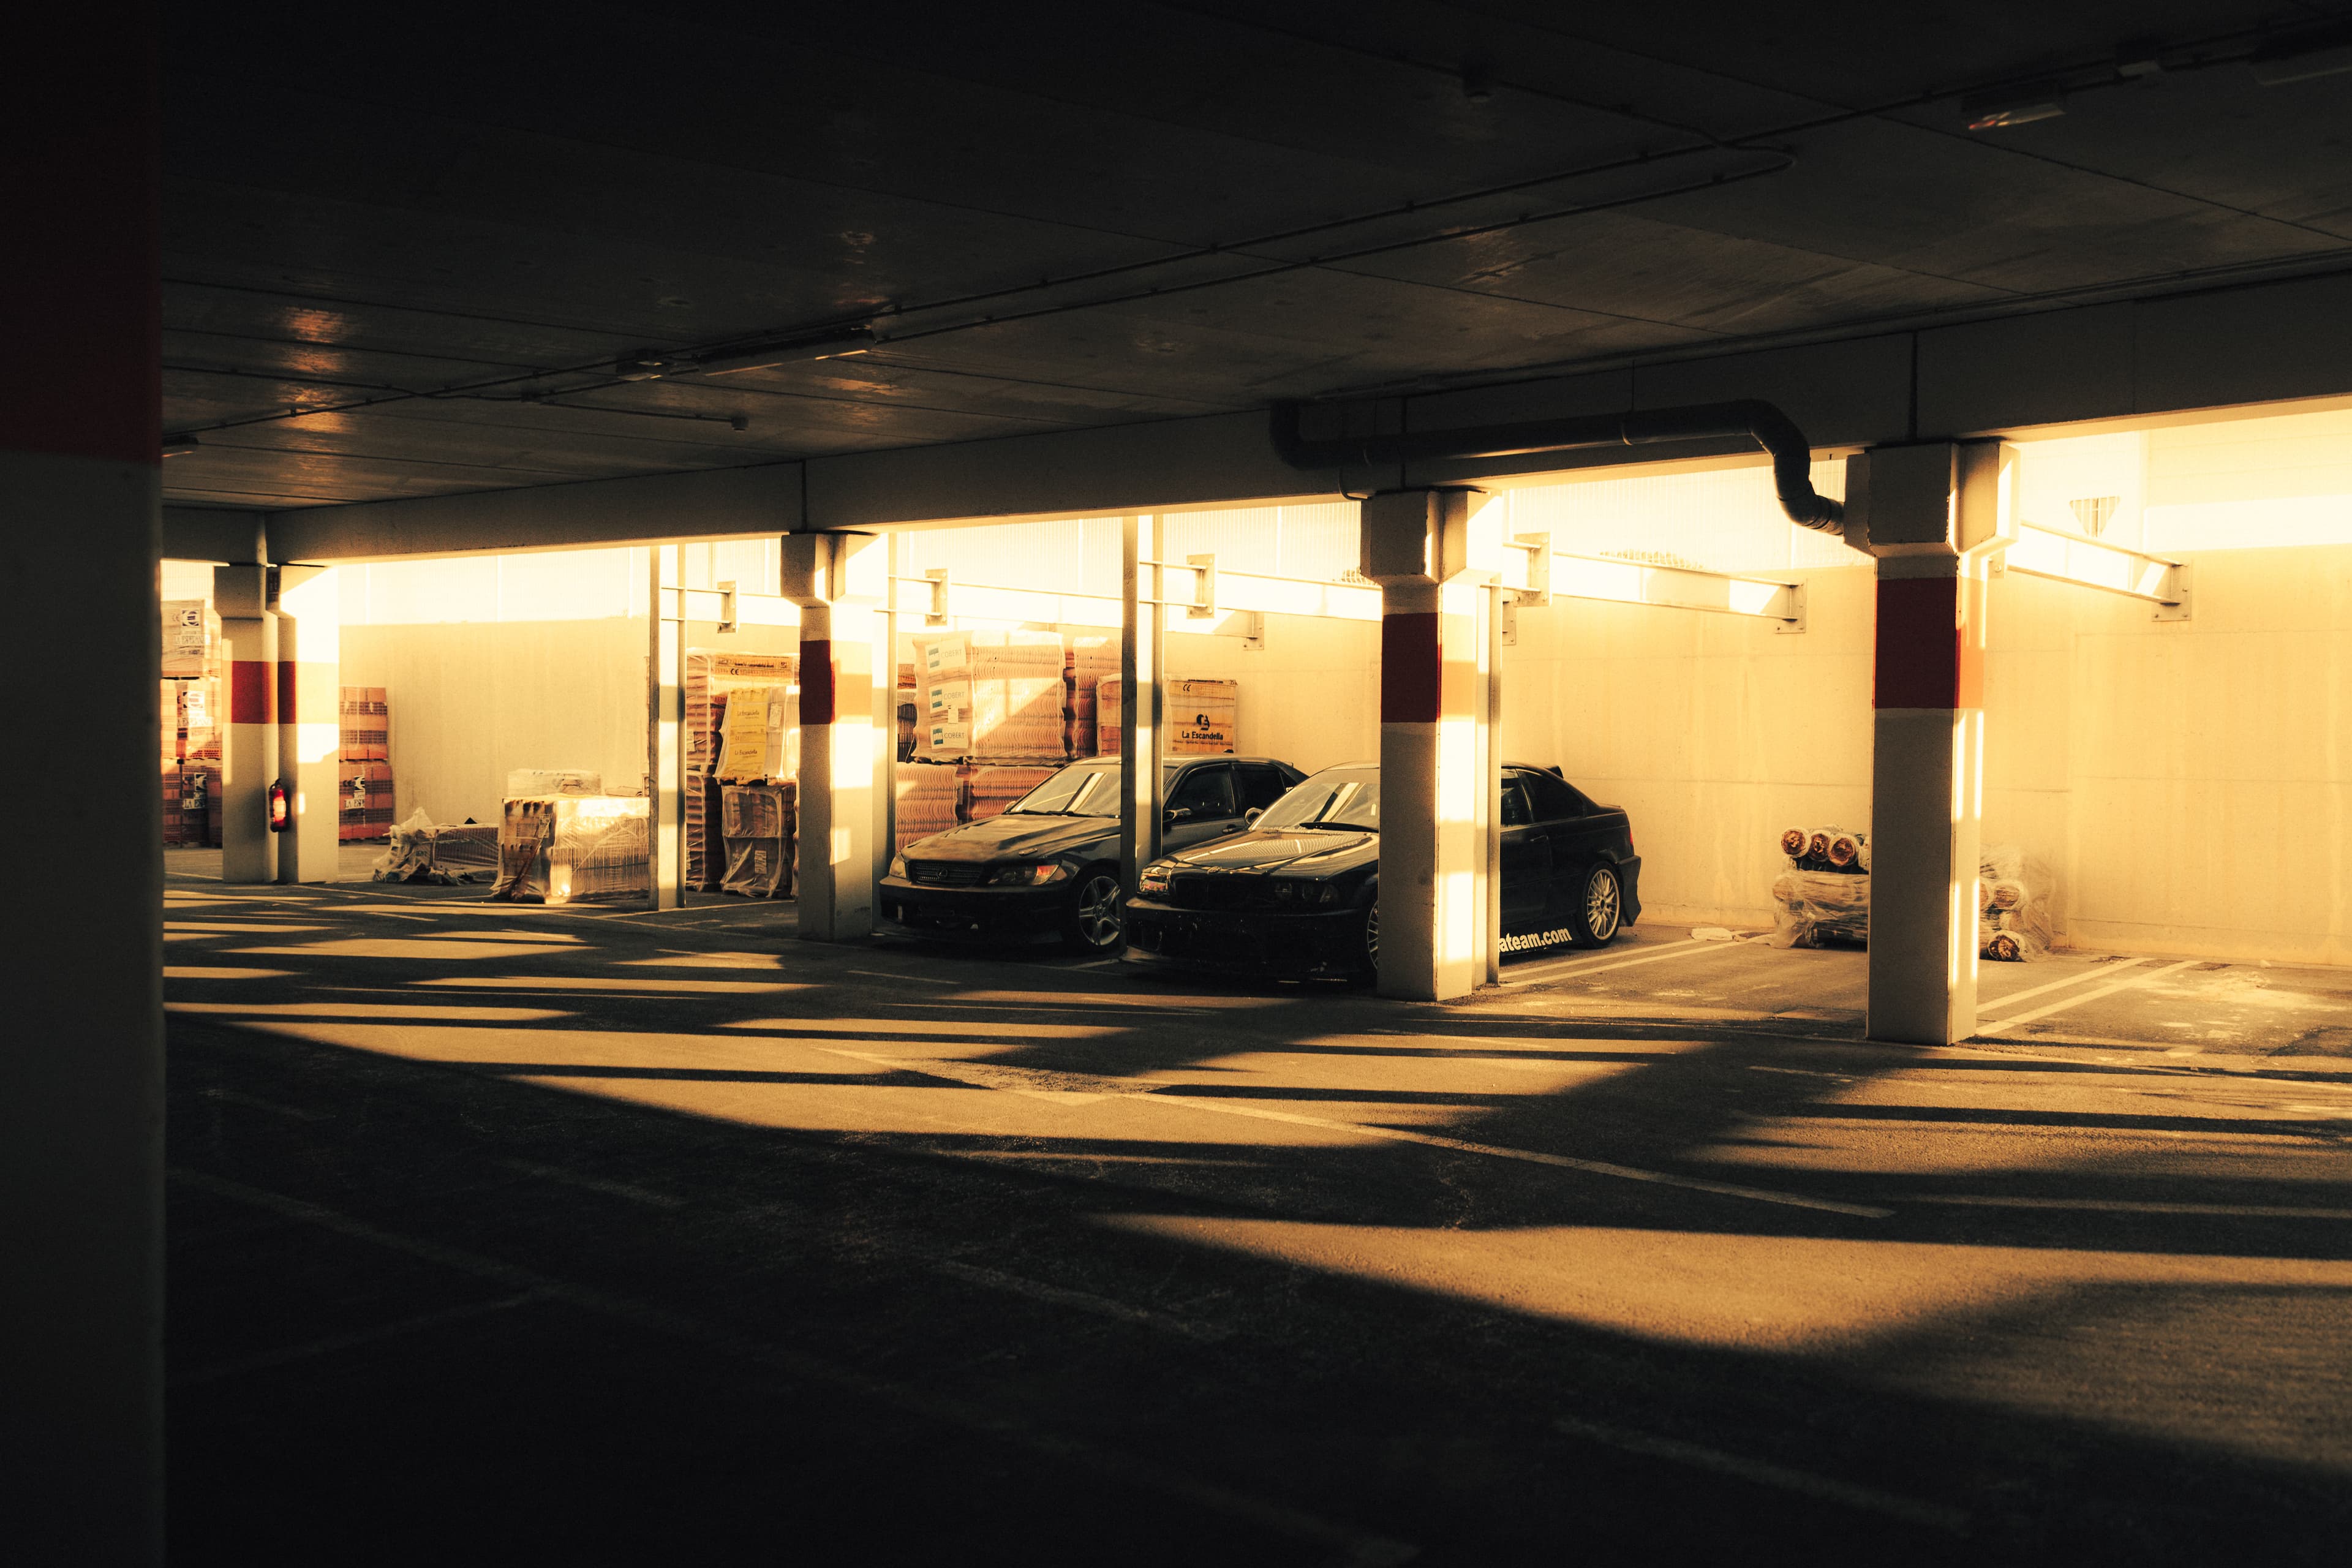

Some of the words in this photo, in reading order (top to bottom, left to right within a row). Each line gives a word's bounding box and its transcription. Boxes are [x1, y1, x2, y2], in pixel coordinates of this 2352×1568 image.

[943, 691, 965, 700] COBERT
[1191, 731, 1224, 741] Escandella
[1499, 928, 1572, 953] ateam.com
